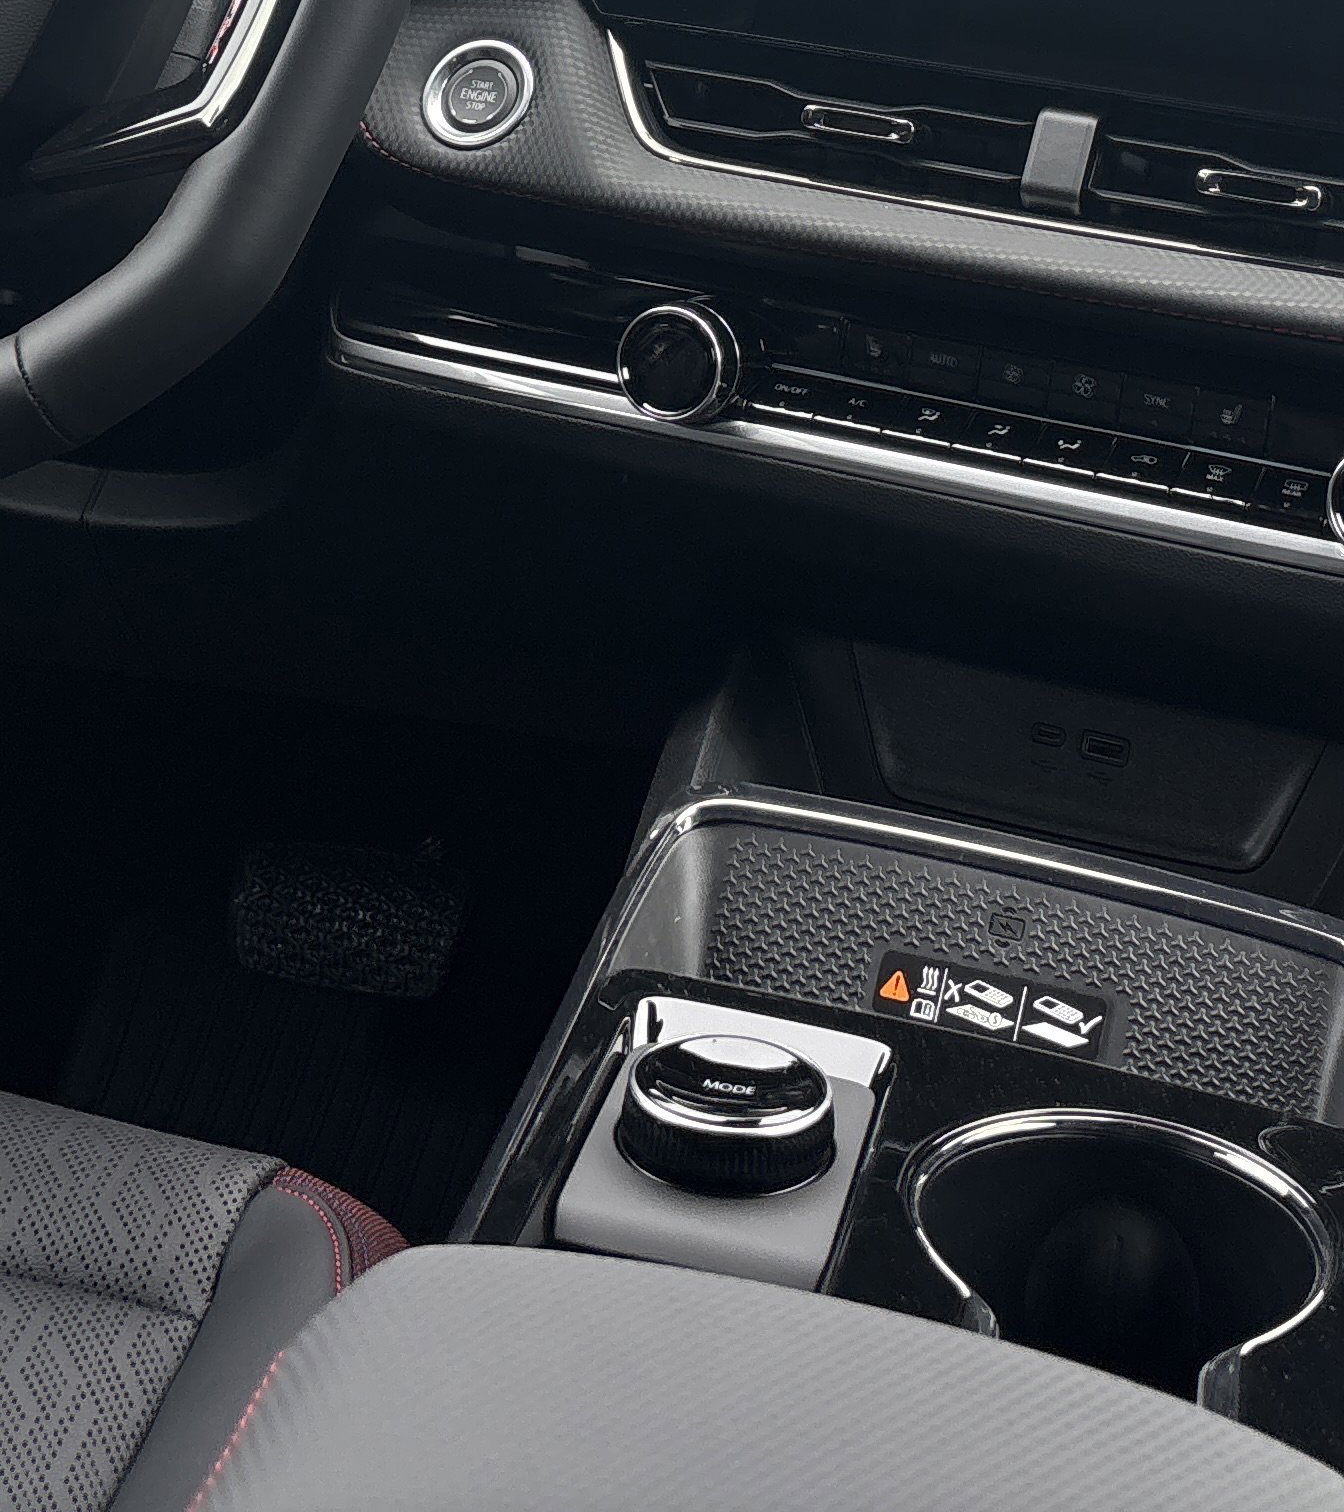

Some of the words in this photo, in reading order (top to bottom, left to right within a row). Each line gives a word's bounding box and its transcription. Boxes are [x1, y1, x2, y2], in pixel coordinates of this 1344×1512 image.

[470, 79, 494, 90] START
[459, 87, 498, 103] ENGINE
[466, 100, 486, 111] STOP
[929, 351, 959, 368] AUTO
[847, 397, 868, 408] A/C
[1143, 393, 1172, 409] SYNC
[702, 1078, 756, 1095] MODE
